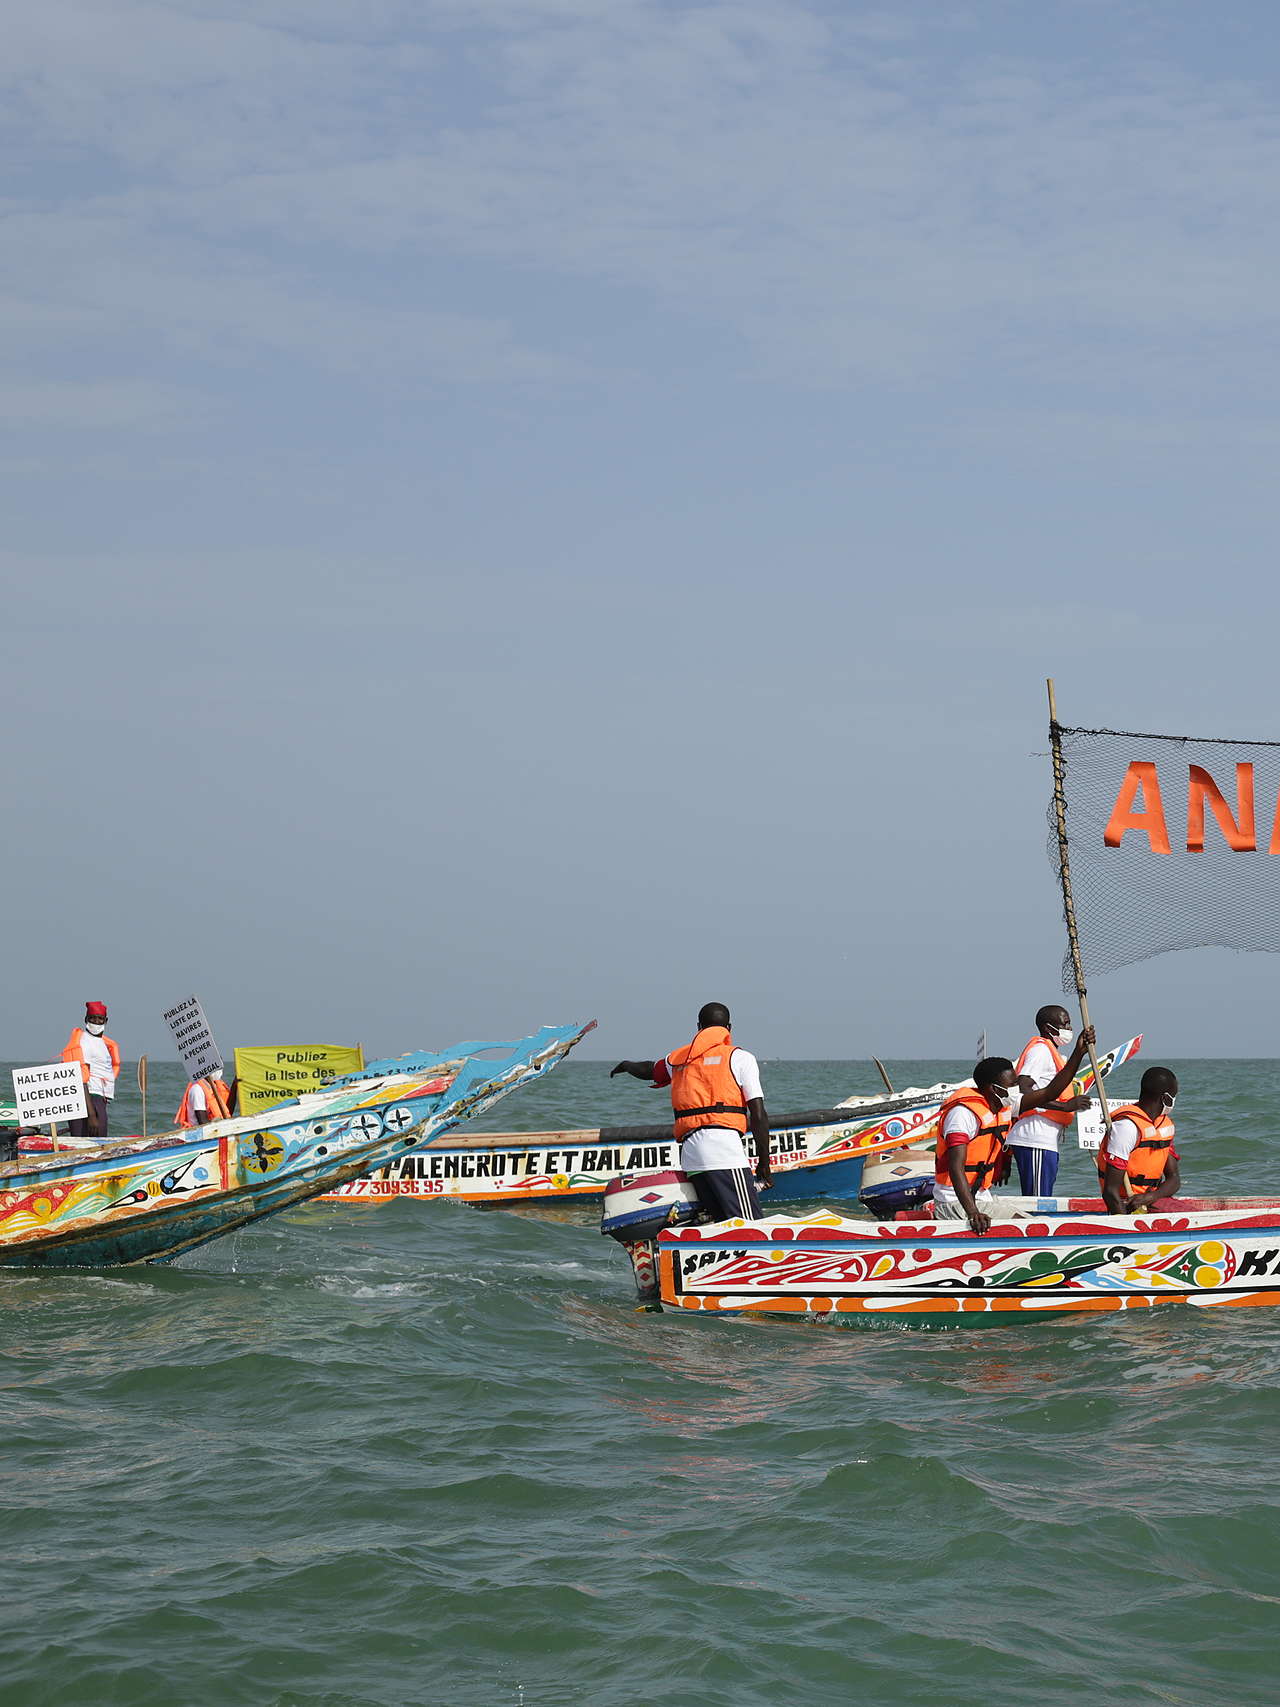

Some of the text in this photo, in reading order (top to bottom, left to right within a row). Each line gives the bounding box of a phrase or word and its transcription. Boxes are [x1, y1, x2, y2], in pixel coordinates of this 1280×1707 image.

[163, 998, 197, 1020] PUBLIEZ LA
[170, 1009, 200, 1030] LISTE DES
[175, 1020, 202, 1039] NAVIRES
[178, 1029, 209, 1051] AUTORISES
[188, 1040, 212, 1058] PECHER
[276, 1051, 327, 1064] Publiez
[197, 1057, 206, 1065] AU
[17, 1068, 76, 1085] HALTE AUX
[192, 1062, 220, 1081] SENEGAL
[265, 1067, 336, 1081] la liste des
[20, 1085, 78, 1103] LICENCES
[250, 1088, 294, 1099] navires
[23, 1109, 36, 1119] DE
[38, 1103, 74, 1117] PECHE
[1083, 1140, 1095, 1148] DE
[544, 1150, 579, 1175] ET
[581, 1145, 672, 1172] BALADE
[423, 1179, 444, 1194] 95
